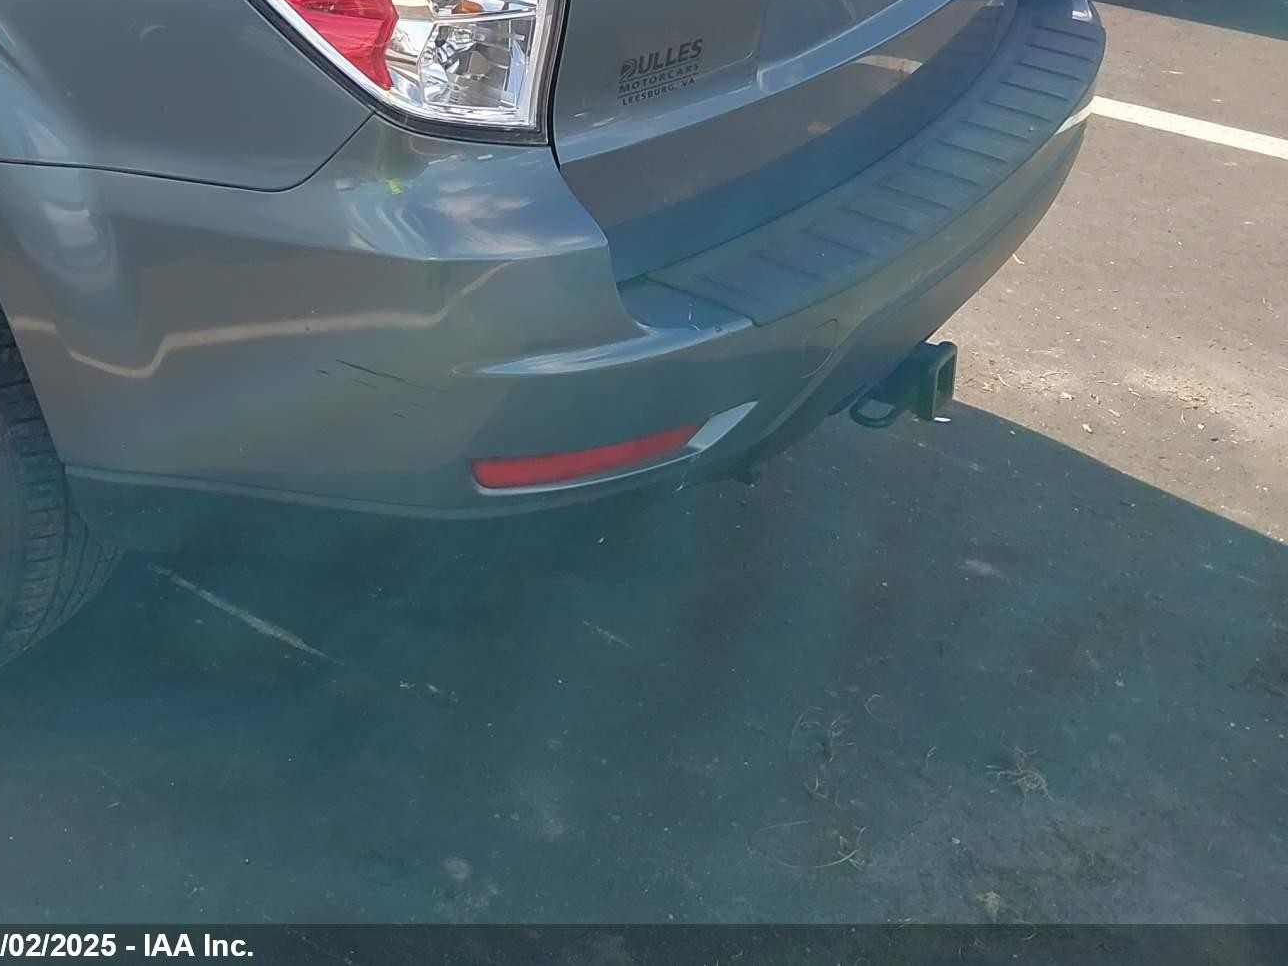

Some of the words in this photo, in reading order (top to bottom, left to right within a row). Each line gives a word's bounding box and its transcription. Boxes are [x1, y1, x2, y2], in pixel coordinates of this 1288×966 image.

[620, 38, 703, 81] DULLES
[618, 63, 700, 95] MOTORCARS
[680, 77, 696, 88] VA
